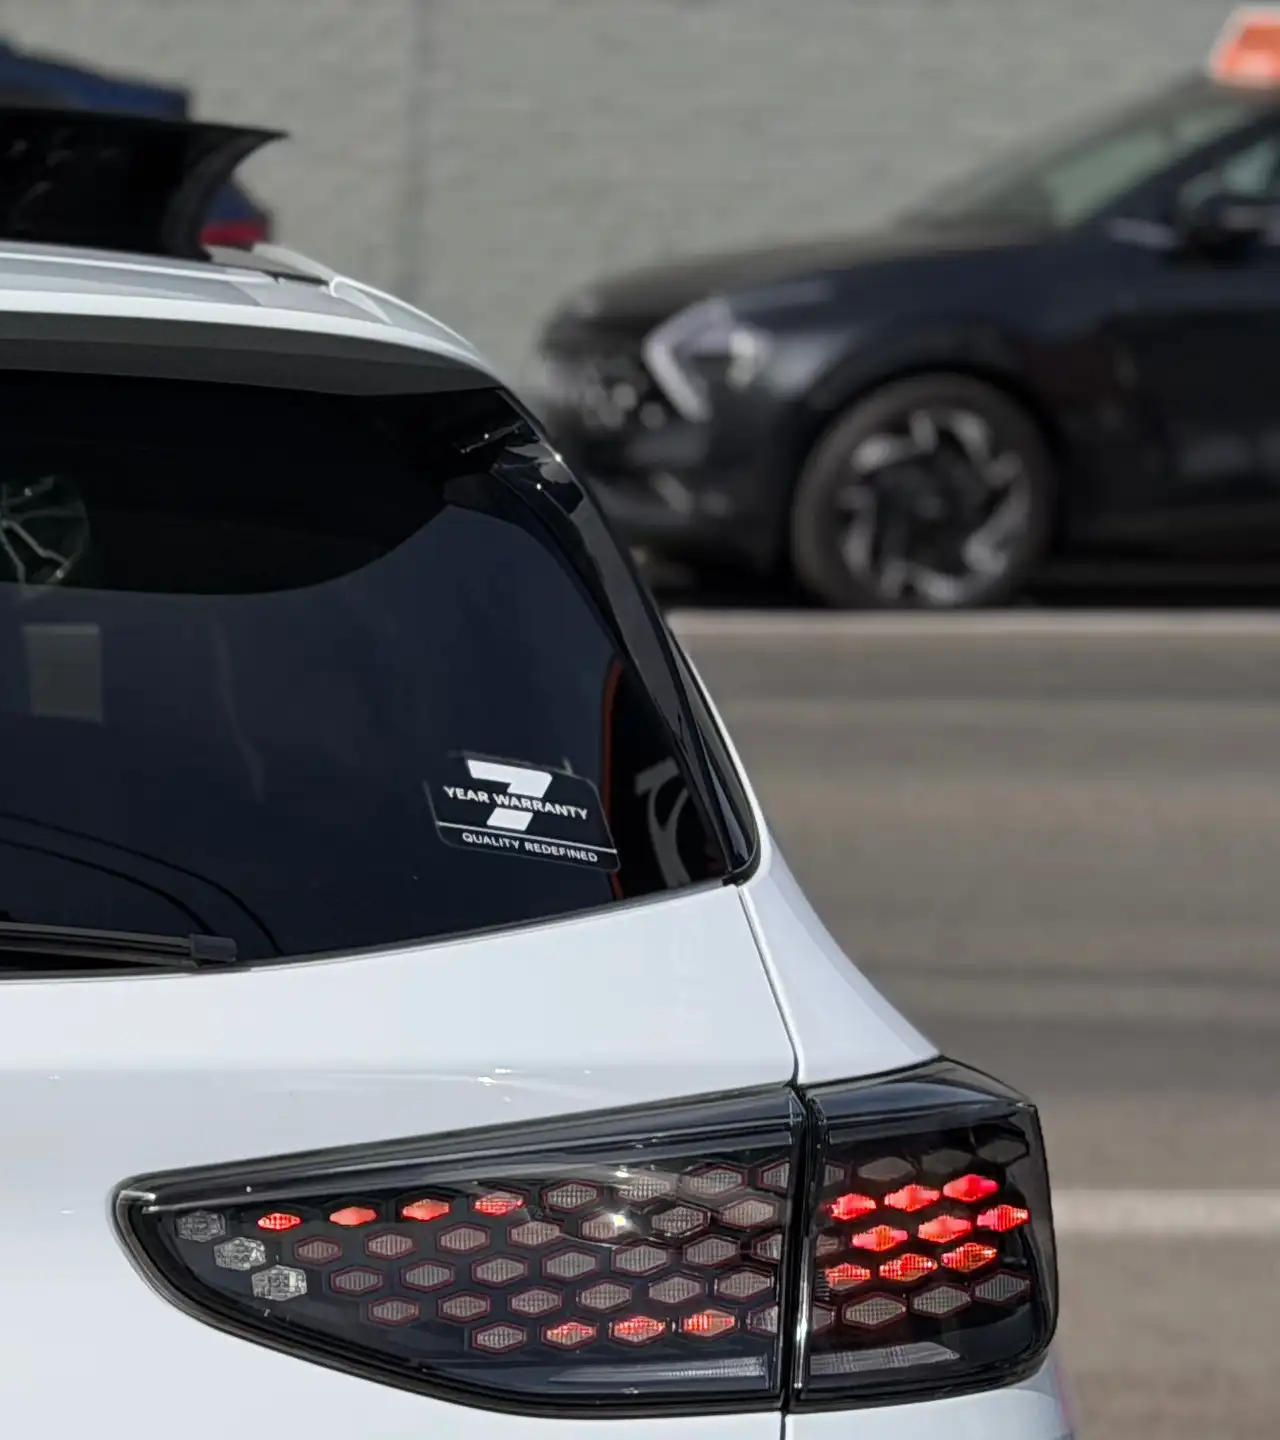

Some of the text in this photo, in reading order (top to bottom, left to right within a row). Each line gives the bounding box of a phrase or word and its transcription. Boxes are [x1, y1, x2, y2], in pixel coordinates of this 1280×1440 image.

[443, 786, 588, 821] YEAR WARRANTY
[466, 759, 553, 831] 7
[462, 832, 599, 863] QUALITY REDEFINED
